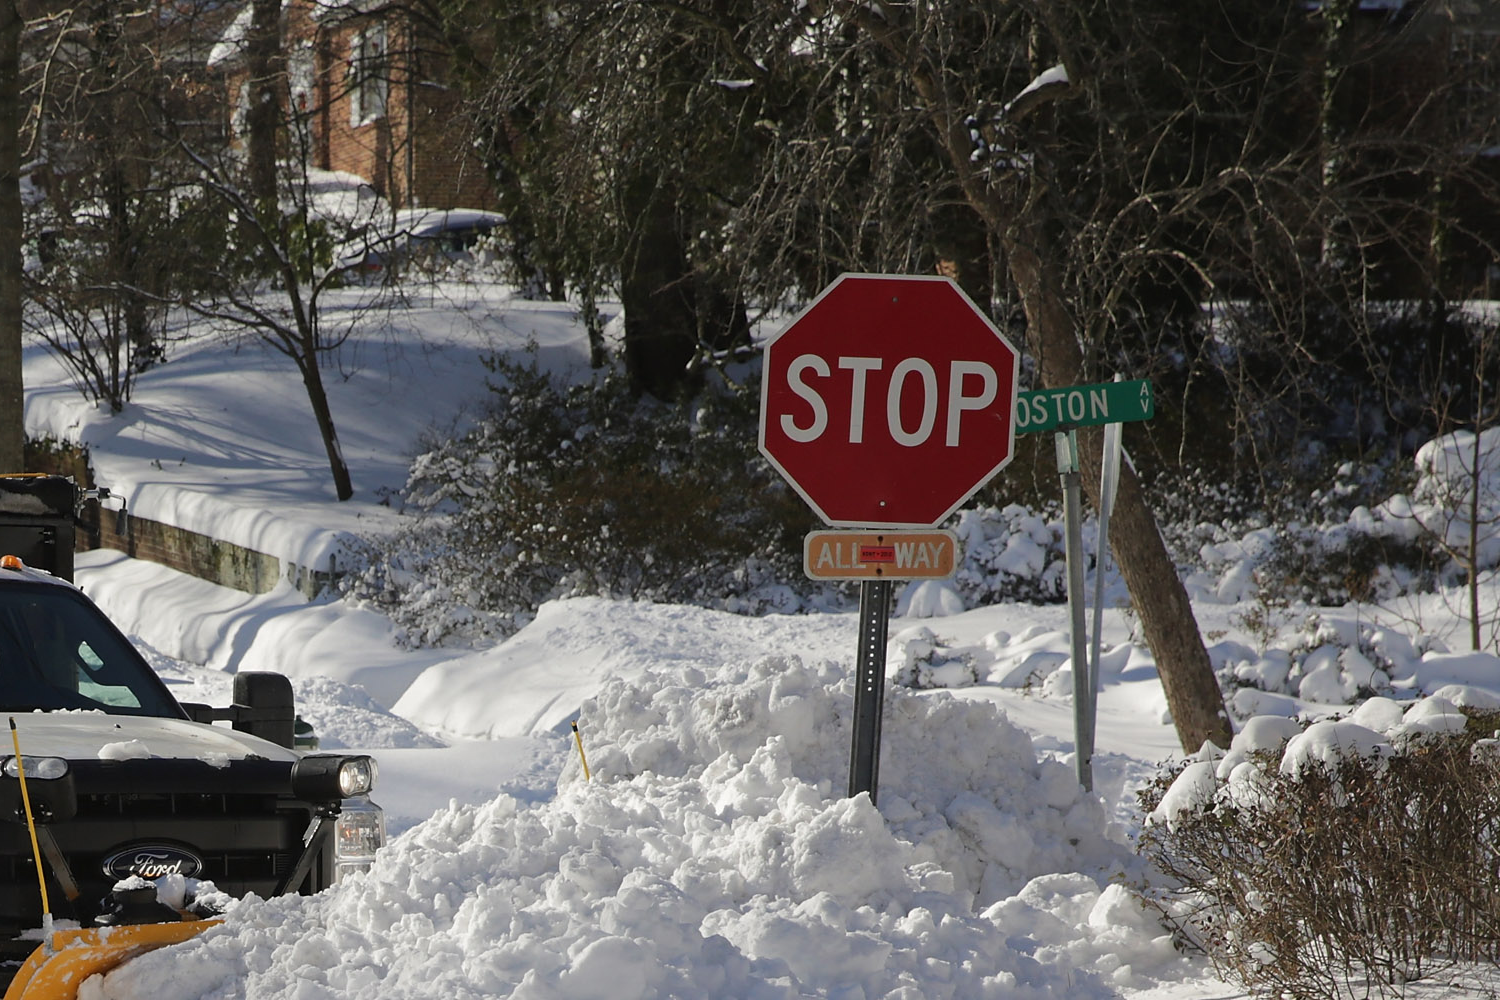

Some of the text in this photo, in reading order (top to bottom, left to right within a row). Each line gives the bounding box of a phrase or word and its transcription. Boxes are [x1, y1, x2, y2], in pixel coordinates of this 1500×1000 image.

[780, 353, 998, 447] STOP
[1015, 388, 1109, 428] OSTON
[817, 542, 946, 569] ALL WAY
[129, 852, 182, 877] Ford
